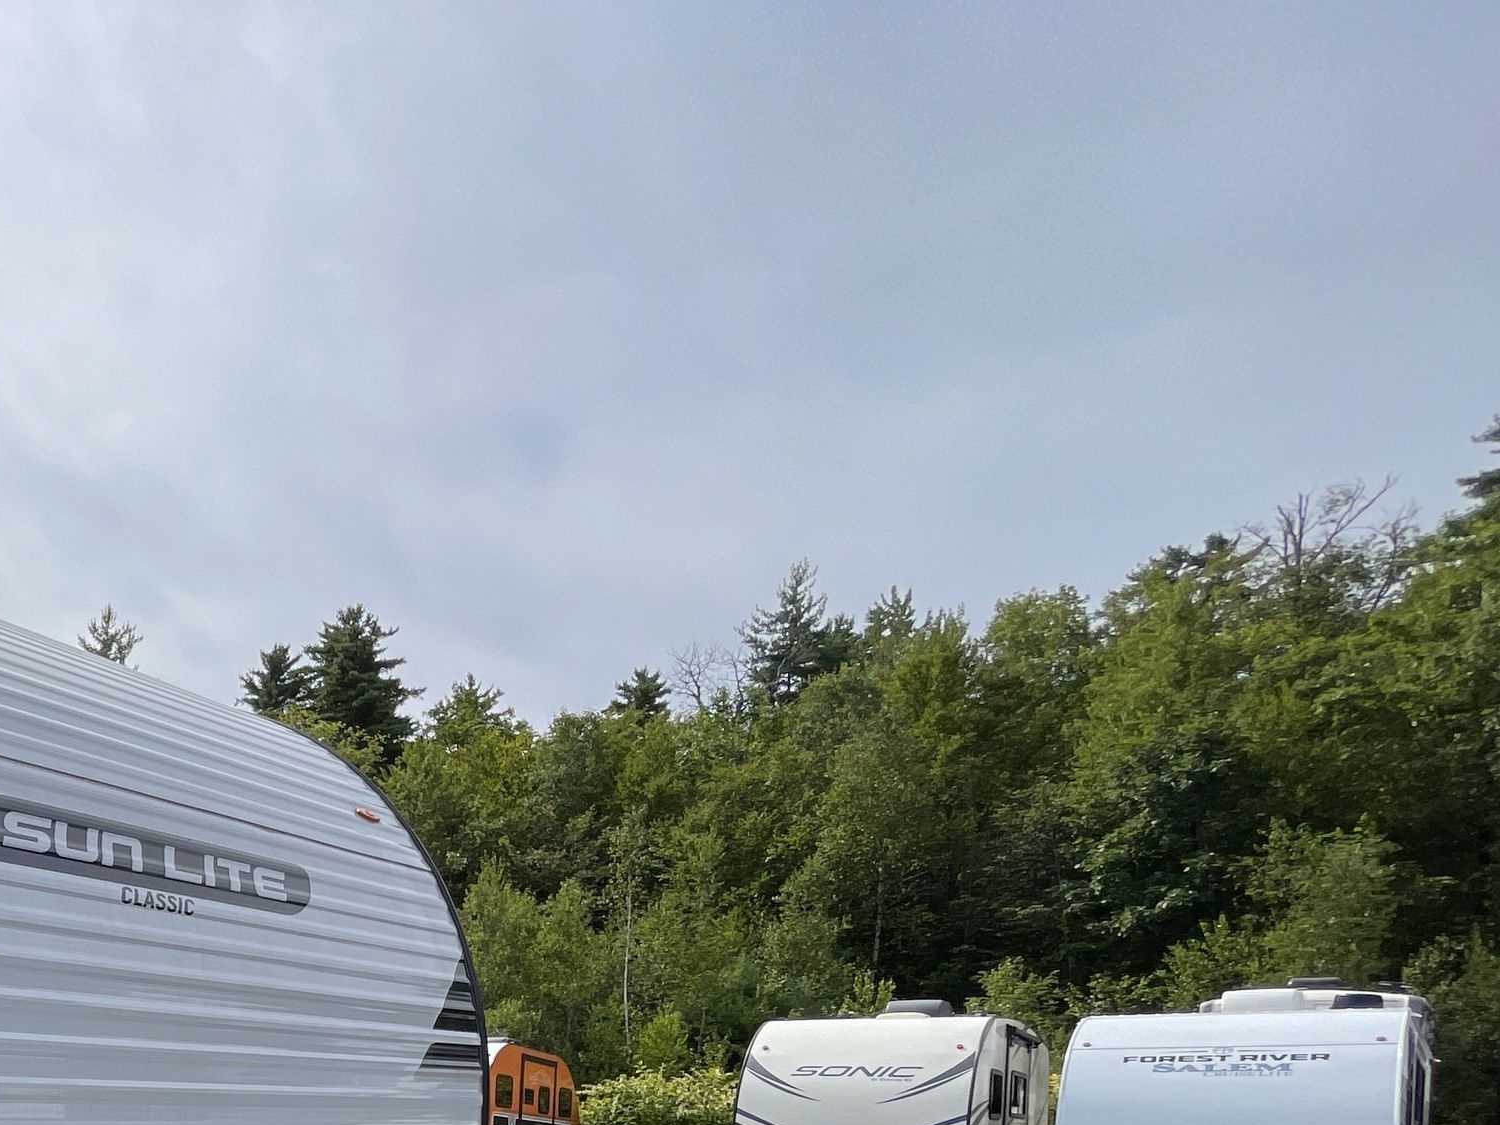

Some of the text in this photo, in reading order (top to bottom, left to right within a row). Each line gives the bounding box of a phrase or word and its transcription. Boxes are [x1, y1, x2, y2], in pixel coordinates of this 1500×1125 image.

[2, 810, 288, 902] SUN LITE
[120, 885, 195, 916] CLASSIC
[1123, 1053, 1330, 1064] FOREST RIVER
[790, 1065, 924, 1078] SONIC
[1152, 1062, 1293, 1073] SALEM
